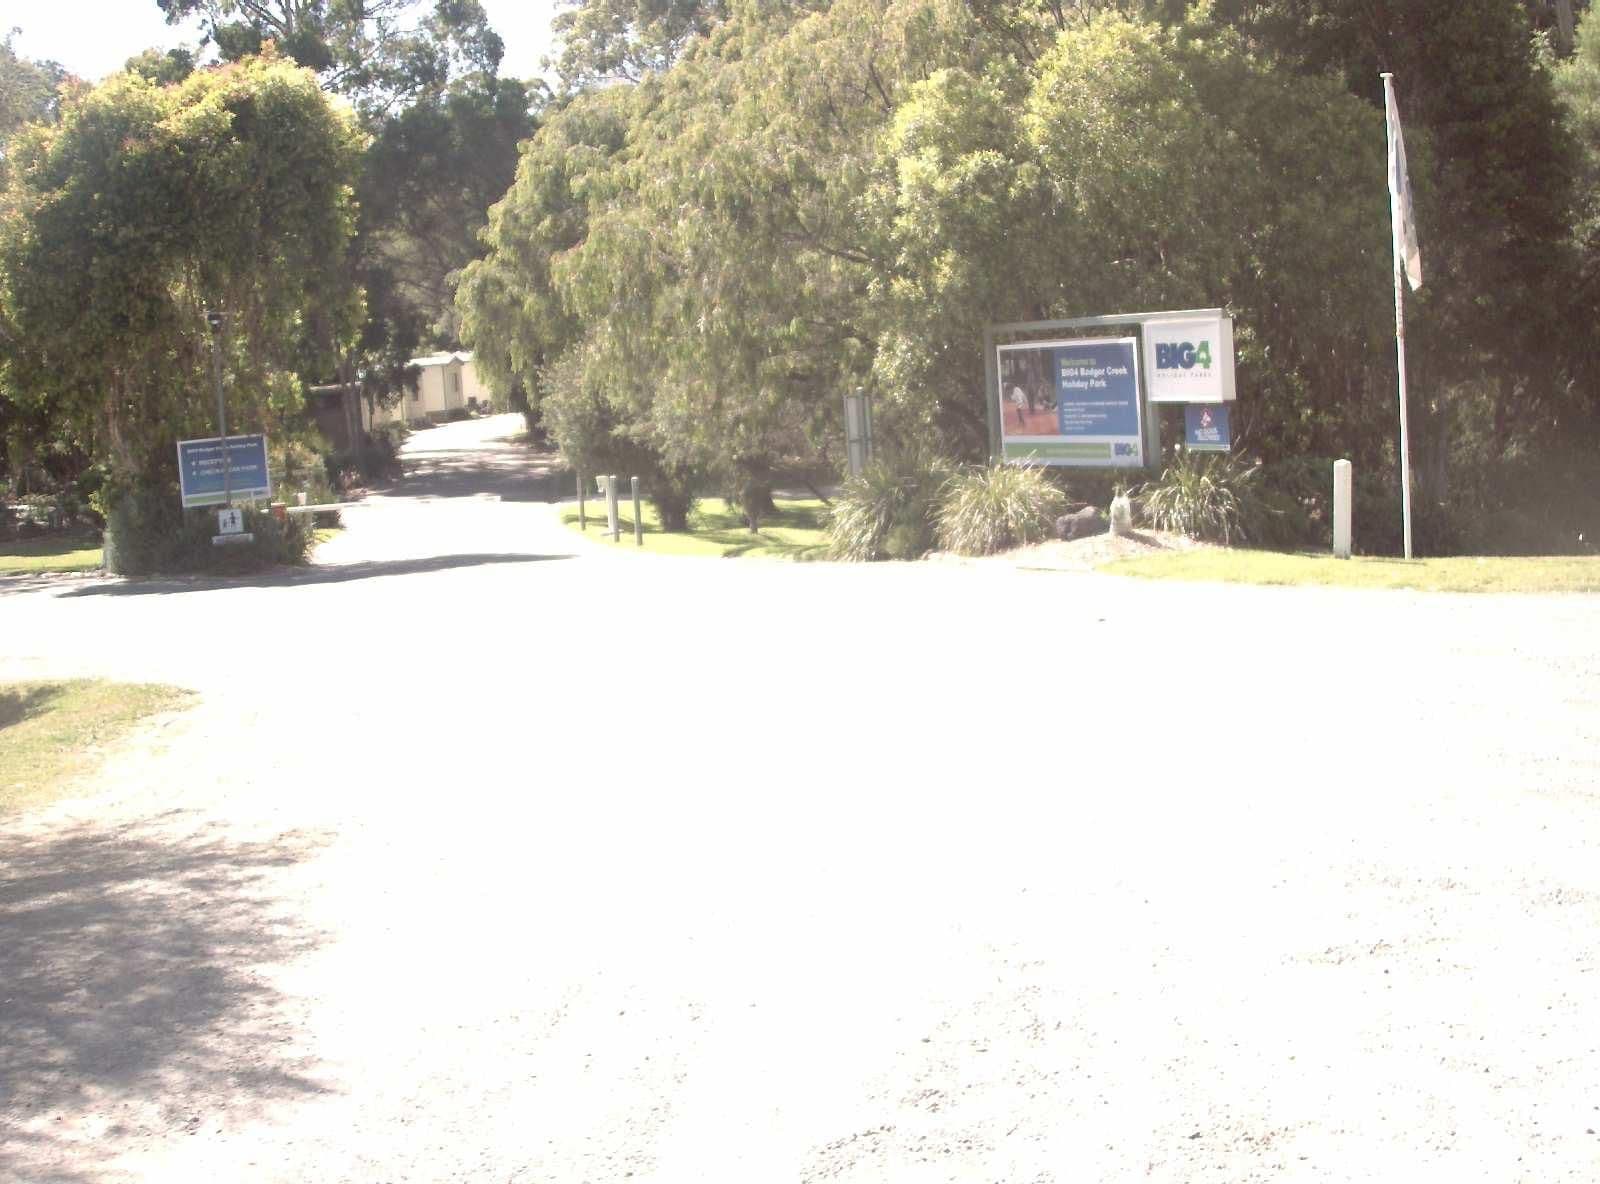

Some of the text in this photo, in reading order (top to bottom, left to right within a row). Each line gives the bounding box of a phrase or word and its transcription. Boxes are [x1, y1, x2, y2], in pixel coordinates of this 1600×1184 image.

[1155, 340, 1212, 369] BIG4
[1106, 365, 1128, 375] Creek
[1062, 378, 1106, 390] Holiday Park
